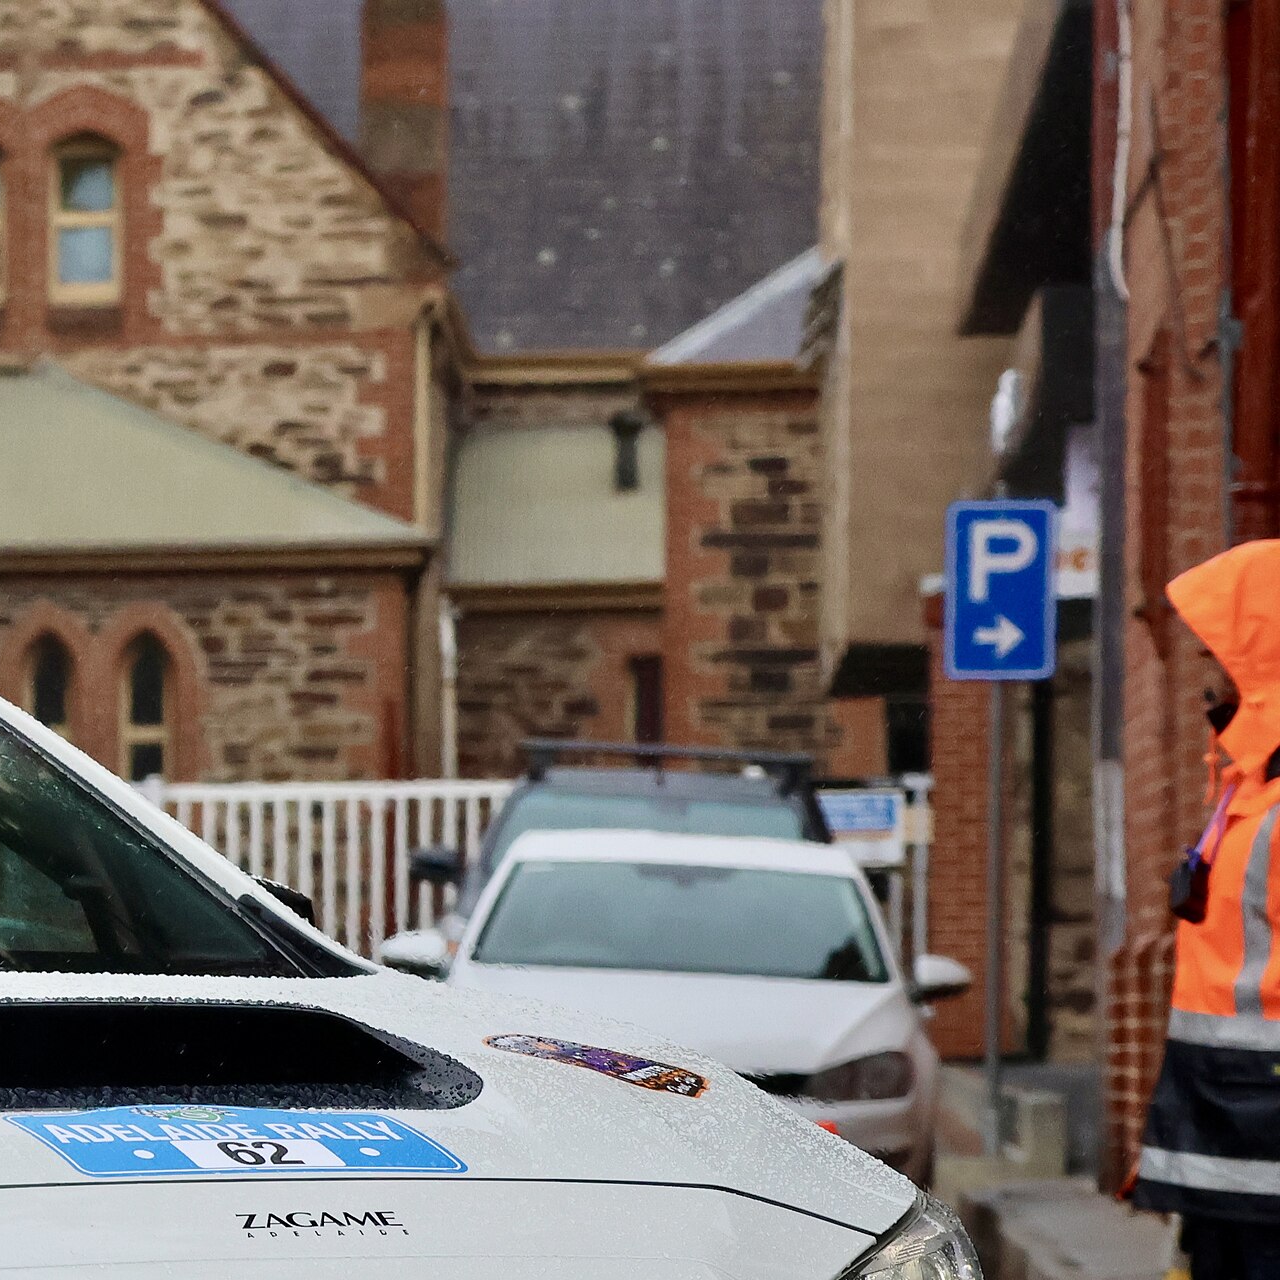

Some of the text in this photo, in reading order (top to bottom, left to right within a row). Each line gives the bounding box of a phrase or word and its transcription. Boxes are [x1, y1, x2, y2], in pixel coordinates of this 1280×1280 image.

[968, 519, 1039, 603] P
[42, 1120, 405, 1144] ADELAIDE RALLY
[216, 1141, 305, 1166] 62
[234, 1210, 403, 1230] ZAGAME
[246, 1229, 410, 1239] ADELAIDE
